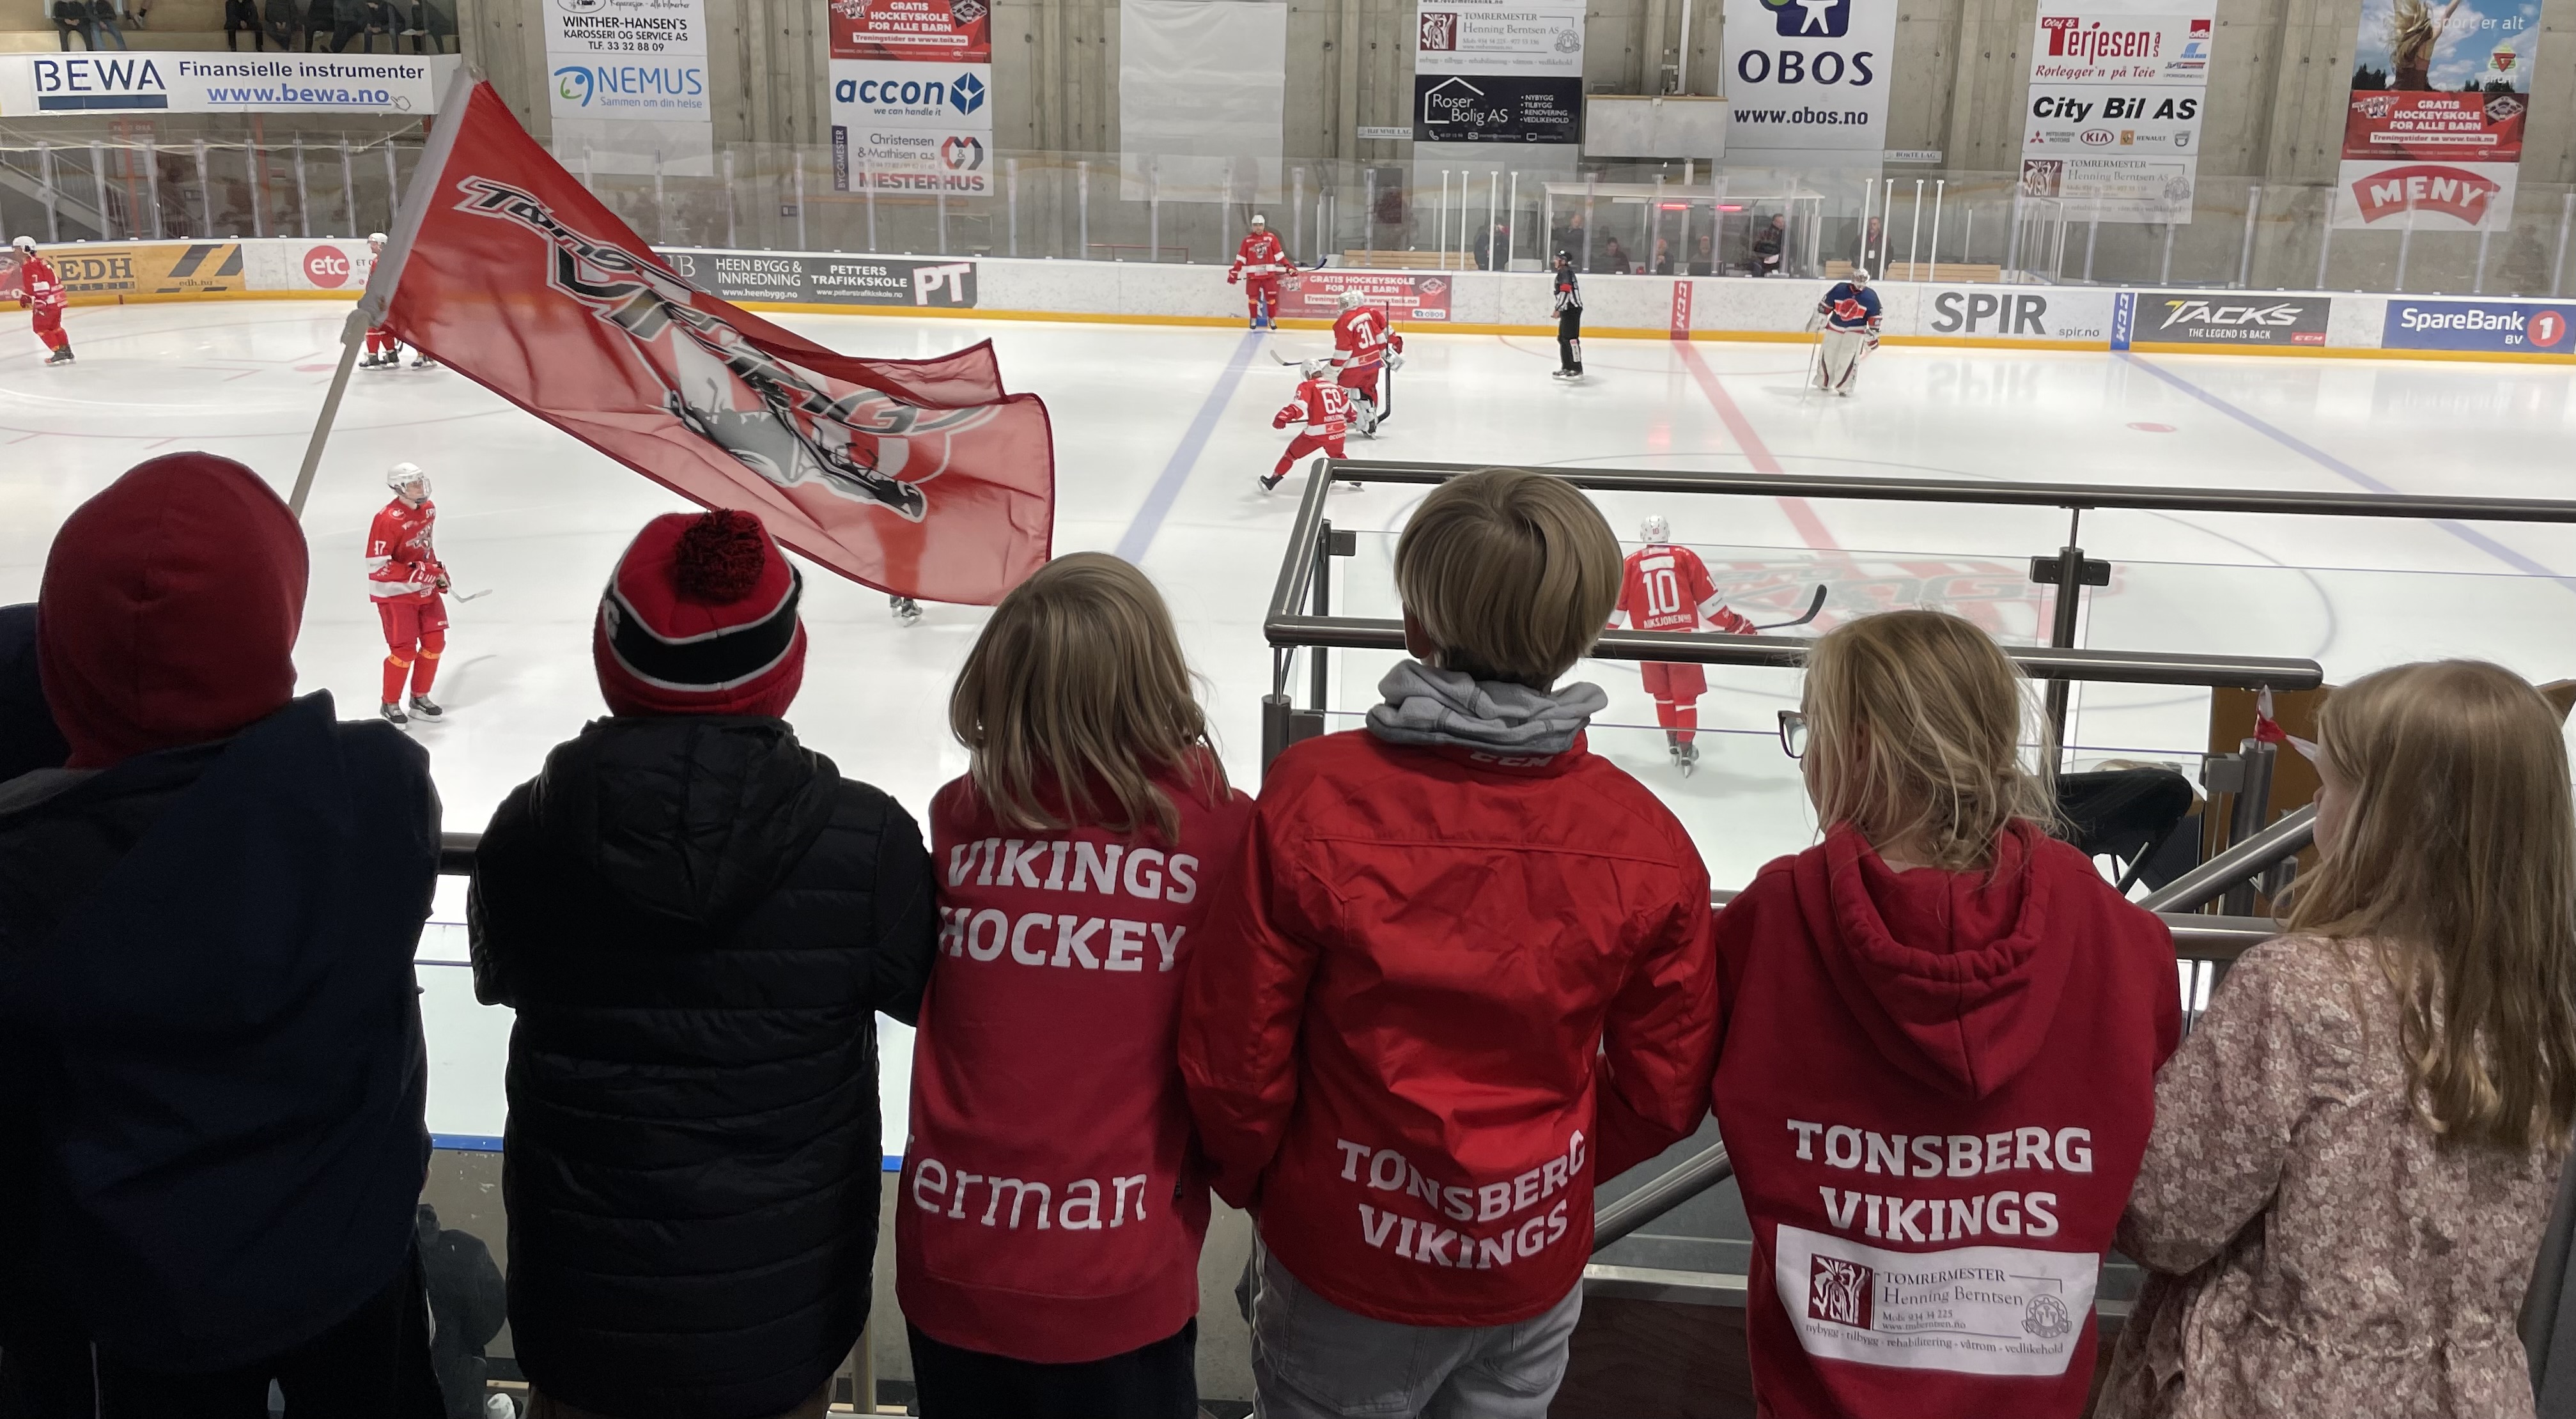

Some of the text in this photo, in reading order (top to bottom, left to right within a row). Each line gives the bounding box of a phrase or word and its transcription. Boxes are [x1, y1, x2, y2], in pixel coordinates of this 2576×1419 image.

[890, 2, 929, 11] GRATIS
[871, 12, 949, 22] HOCKEYSKOLE
[2044, 19, 2065, 29] Olaf
[2481, 19, 2497, 29] er
[2502, 15, 2525, 30] alt
[869, 22, 952, 33] FOR ALLE BARN
[1464, 22, 1505, 35] Henning
[1507, 24, 1546, 35] Berntsen
[564, 30, 688, 42] KAROSSERI OG SERVICE AS
[855, 35, 906, 43] Treningstider
[2042, 17, 2150, 66] Terjesen
[588, 41, 664, 52] TLF. 33 32 88 09
[179, 61, 424, 81] Finansielle instrumenter
[1738, 50, 1874, 86] OBOS
[2111, 66, 2127, 81] på
[2133, 66, 2155, 78] Teie
[34, 59, 166, 93] BEWA
[598, 66, 702, 95] NEMUS
[208, 83, 390, 104] www.bewa.no
[835, 79, 945, 105] accon
[601, 97, 702, 109] Sammen om din helse
[1432, 94, 1474, 108] Roser
[2417, 100, 2460, 109] GRATIS
[904, 107, 933, 116] handle
[1451, 108, 1509, 126] Bolig AS
[1734, 107, 1868, 125] www.obos.no
[2033, 97, 2198, 123] City Bil AS
[2394, 111, 2480, 120] HOCKEYSKOLE
[2389, 121, 2481, 131] FOR ALLE BARN
[870, 133, 934, 146] Christensen
[2086, 133, 2109, 142] KIA
[835, 130, 846, 189] BYGGMESTER
[858, 147, 866, 158] &
[867, 148, 916, 160] Mathisen
[859, 172, 984, 191] MESTERHUS
[2068, 169, 2111, 182] Henning
[2114, 171, 2155, 182] Berntsen
[2370, 176, 2484, 208] MENY
[716, 258, 802, 273] HEEN BYGG &
[830, 265, 887, 276] PETTERS
[718, 272, 801, 286] INNREDNING
[811, 275, 908, 288] TRAFIKKSKOLE
[913, 263, 971, 306] PT
[1310, 275, 1415, 286] GRATIS HOCKEYSKOLE
[722, 288, 798, 299] www.heenbygg.no
[1372, 285, 1399, 293] BARN
[1931, 291, 2047, 335] SPIR
[2159, 300, 2303, 330] TACKS
[2401, 307, 2553, 340] SpareBank 1
[1356, 321, 1376, 350] 31
[2058, 327, 2100, 338] spir.no
[2189, 328, 2270, 339] THE LEGEND IS BACK
[2505, 334, 2524, 345] BV
[1321, 389, 1343, 414] 69
[1643, 570, 1680, 617] 10
[948, 837, 1200, 904] VIKINGS
[938, 906, 1186, 973] HOCKEY
[1787, 1119, 2093, 1177] TØNSBERG
[1337, 1129, 1587, 1223] TØNSBERG
[1819, 1186, 2060, 1243] VIKINGS
[1358, 1199, 1569, 1270] VIKINGS
[1883, 1285, 2024, 1307] Henning Berntsen
[1937, 1309, 1953, 1319] 225
[1806, 1324, 2064, 1354] nybygg tilbygg rehabilitering våtrom vedlikehold
